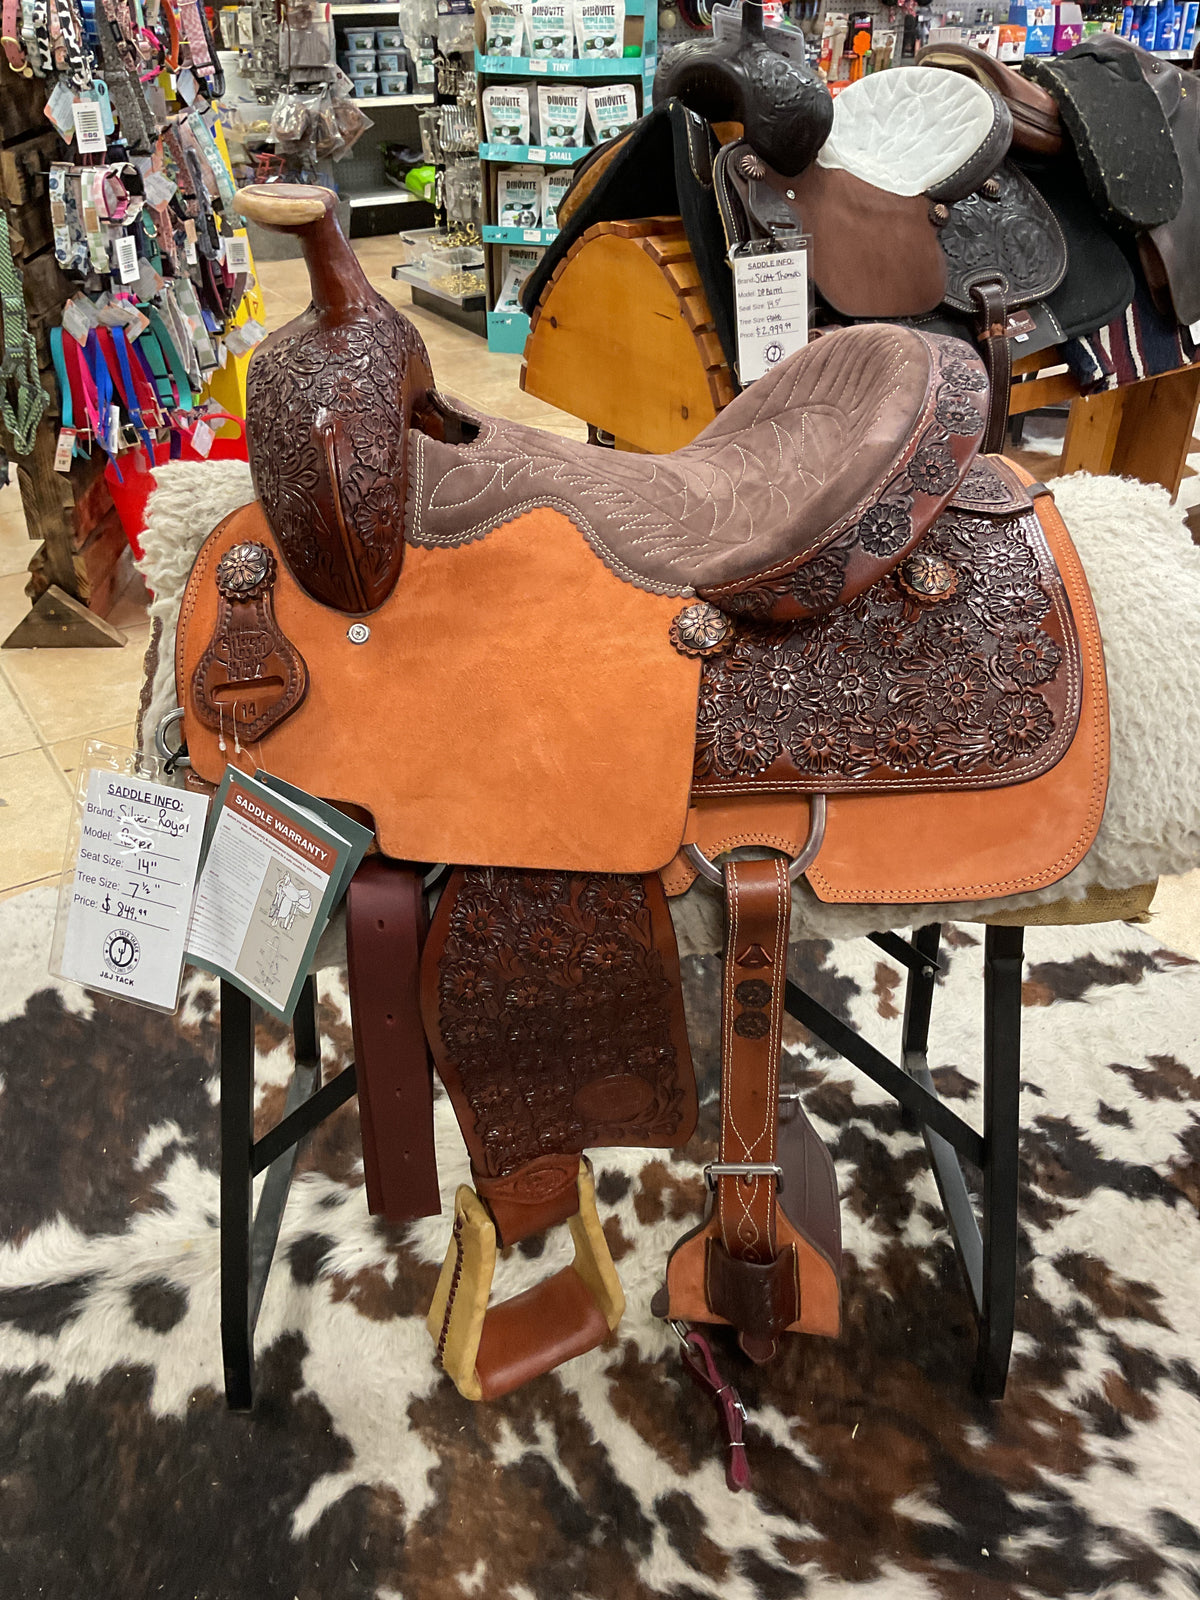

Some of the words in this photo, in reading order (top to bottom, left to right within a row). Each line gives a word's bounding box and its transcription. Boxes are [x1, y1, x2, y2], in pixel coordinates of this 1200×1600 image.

[552, 63, 570, 72] TINY
[549, 152, 572, 161] SMALL
[747, 260, 775, 270] SADDLE
[241, 702, 257, 719] 14
[107, 784, 152, 804] SADDLE
[154, 794, 185, 812] INFO:
[86, 802, 116, 818] Brand:
[158, 808, 190, 837] Royal
[235, 794, 274, 825] SADDLE
[274, 818, 328, 861] WARRANTY
[83, 825, 113, 841] Model:
[80, 848, 101, 862] Seat
[102, 854, 124, 869] Size:
[77, 871, 98, 885] Tree
[99, 876, 121, 891] Size:
[73, 893, 99, 909] Price:
[100, 971, 114, 980] J&J
[115, 975, 135, 986] TACK
